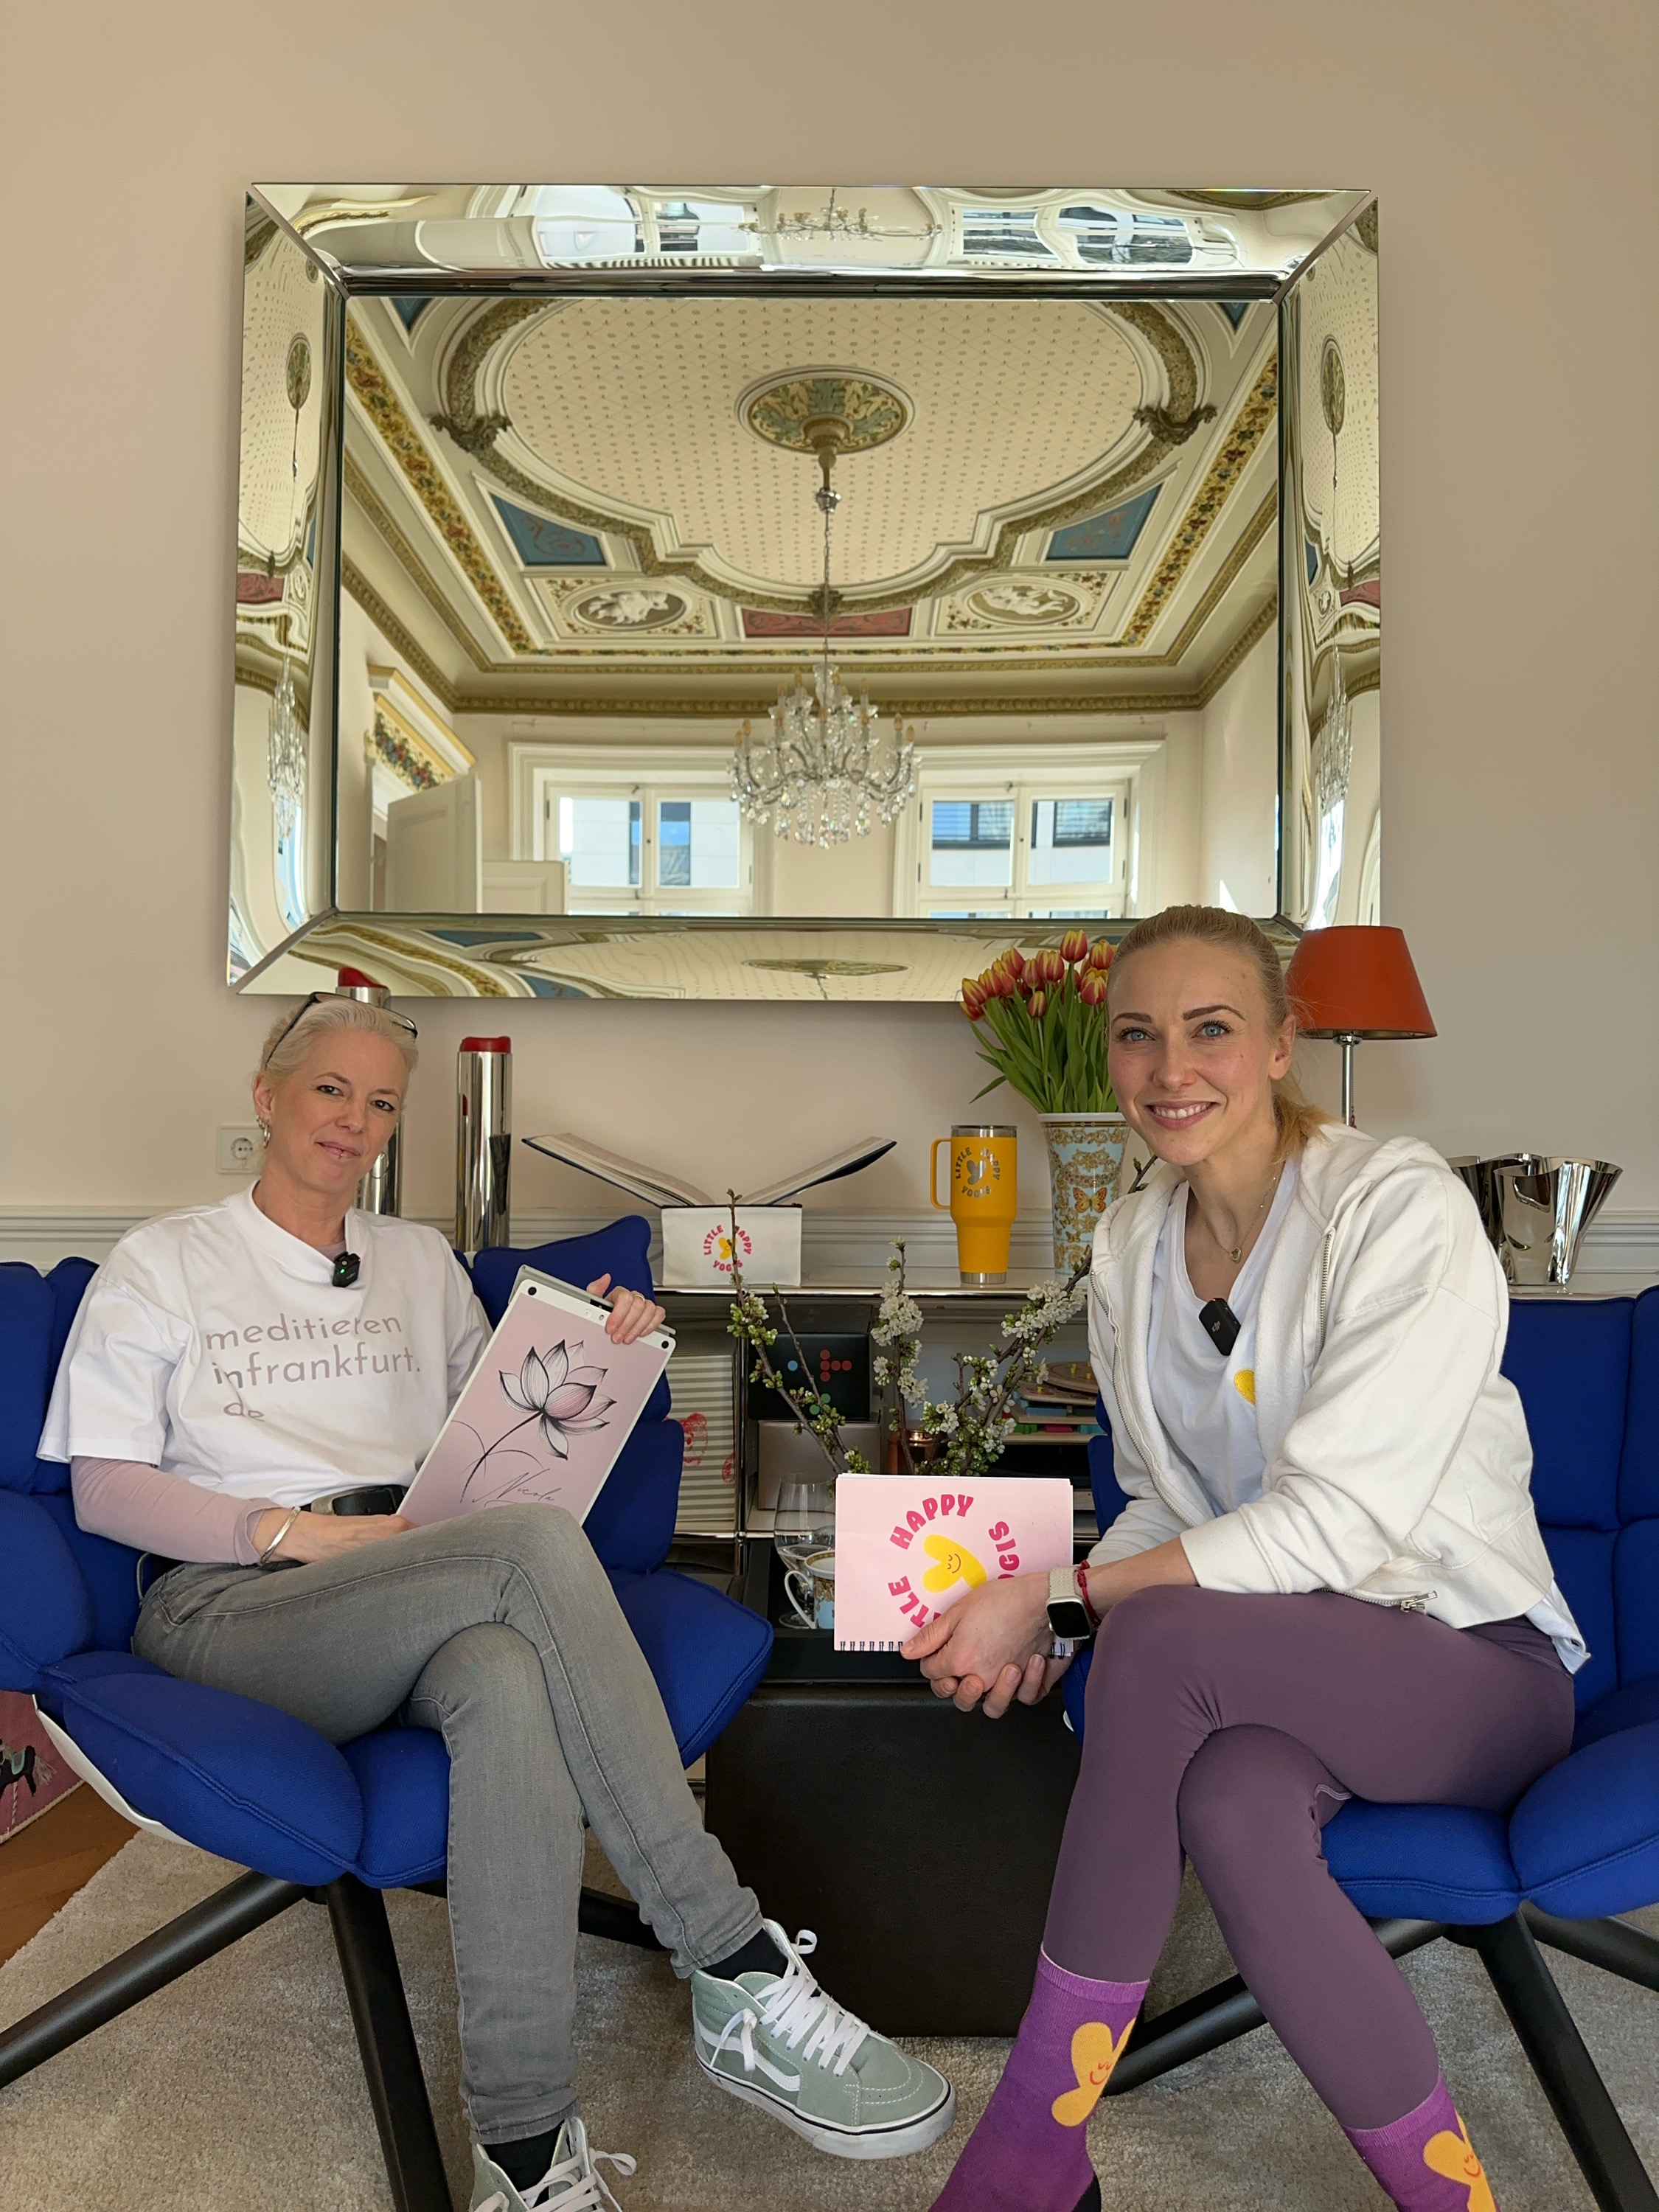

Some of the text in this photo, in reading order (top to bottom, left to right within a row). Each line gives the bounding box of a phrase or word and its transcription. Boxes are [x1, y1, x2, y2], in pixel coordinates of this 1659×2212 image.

[956, 1147, 972, 1179] LITTLE
[703, 1224, 752, 1272] LITTLE APPY YOGS
[206, 1312, 403, 1351] meditieren
[223, 1399, 265, 1422] de
[889, 1494, 974, 1550] HAPPY
